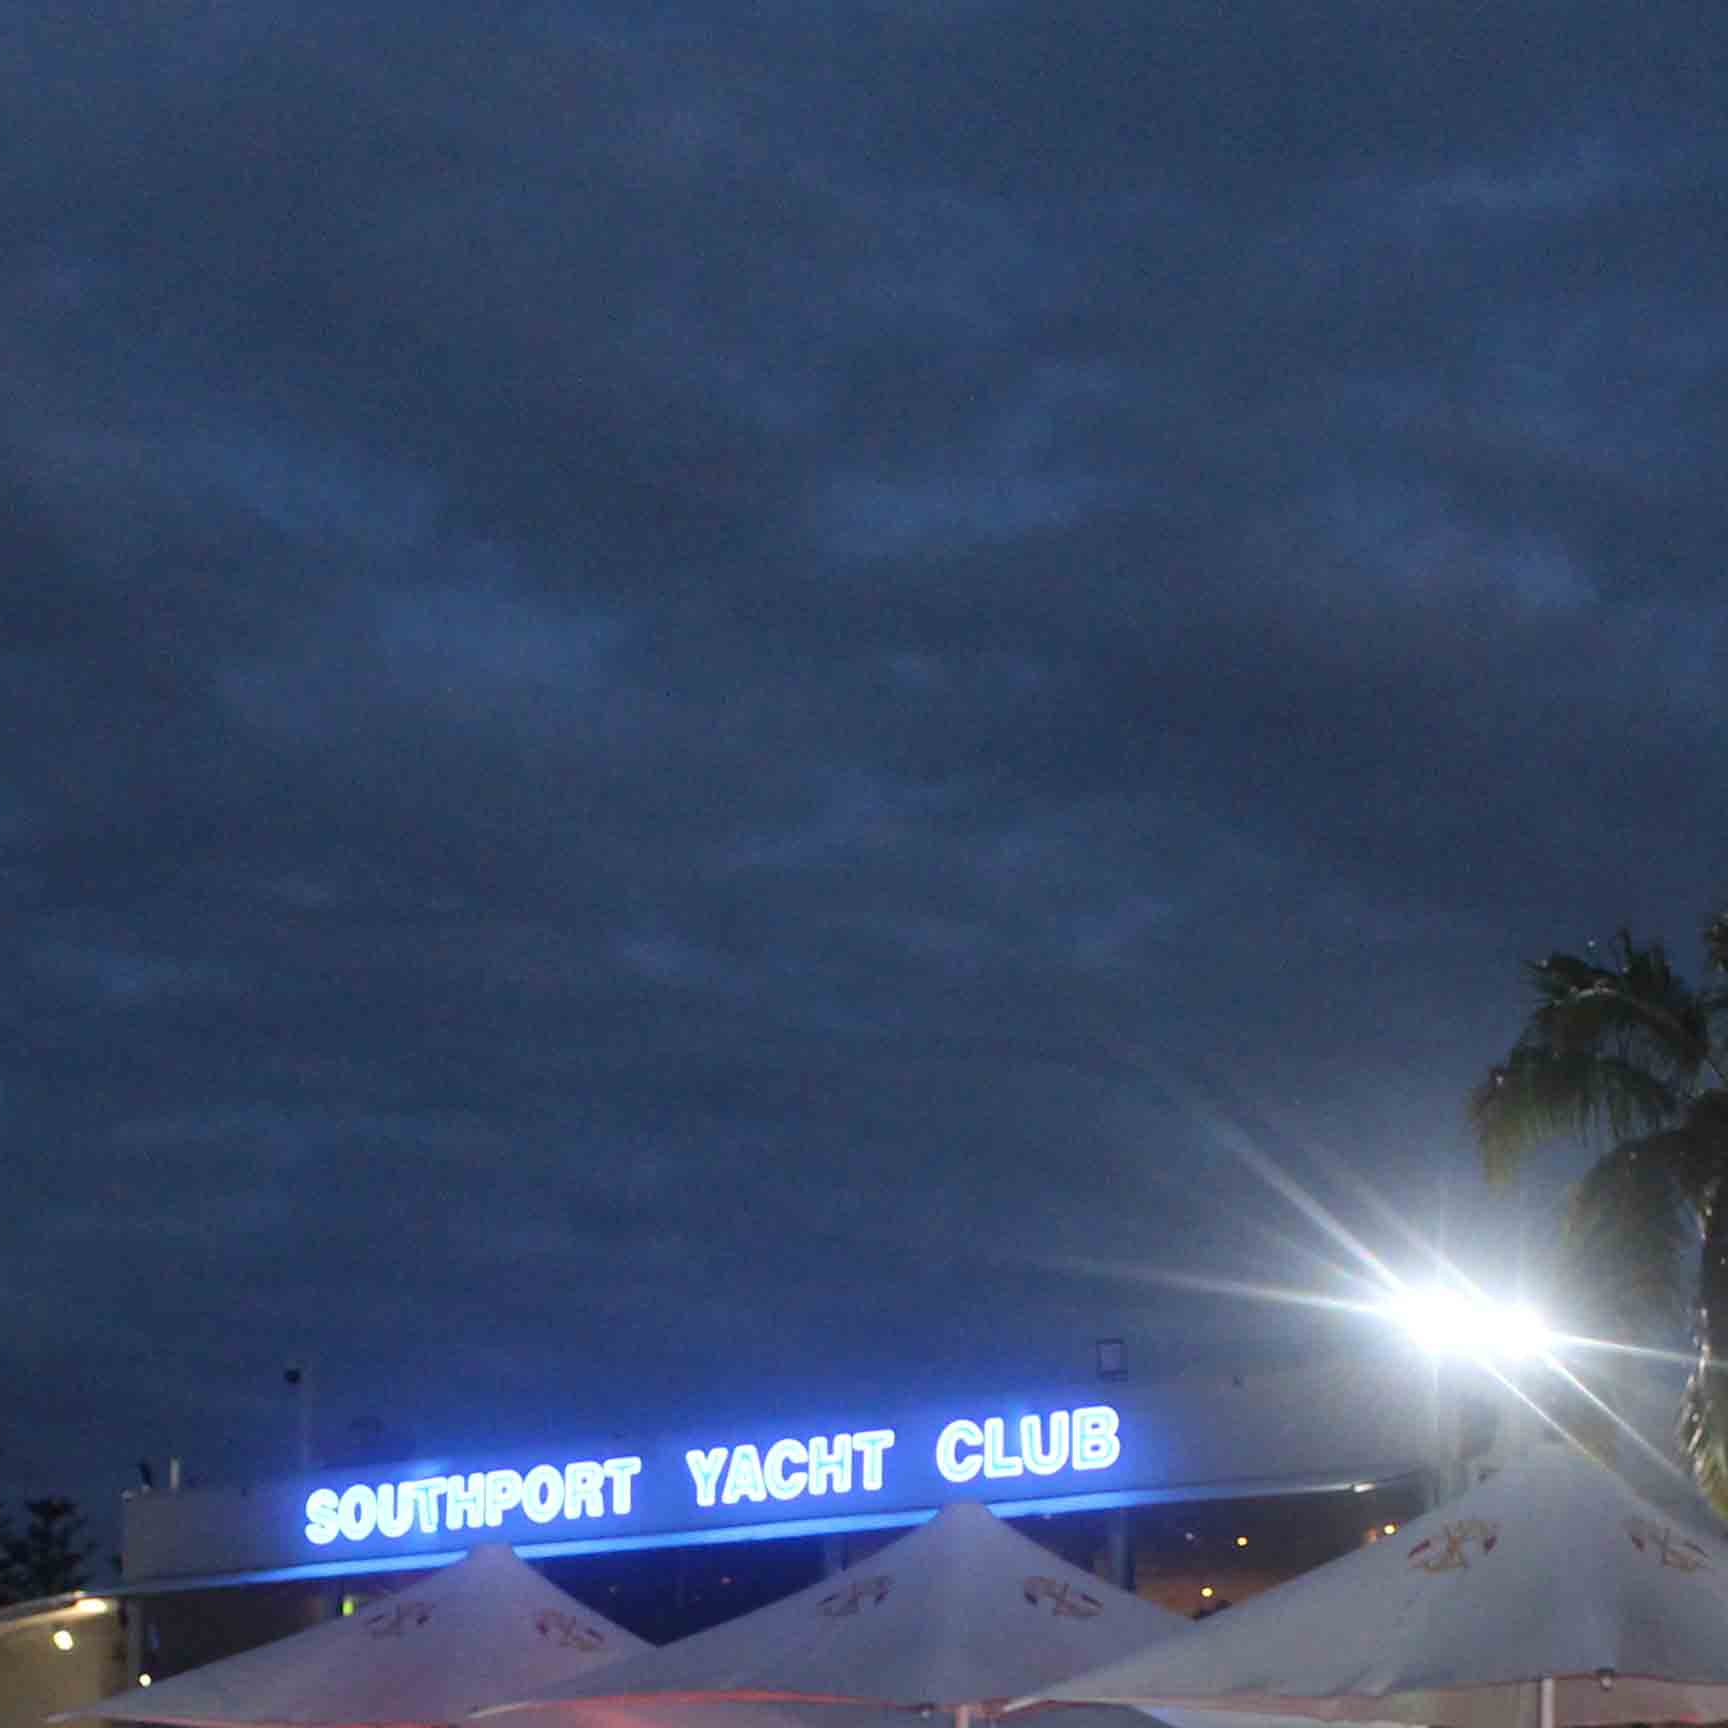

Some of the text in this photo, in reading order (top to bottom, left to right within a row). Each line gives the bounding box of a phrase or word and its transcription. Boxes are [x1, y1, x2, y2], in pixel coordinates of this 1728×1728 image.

[304, 1404, 1121, 1544] SOUTHPORT YACHT CLUB
